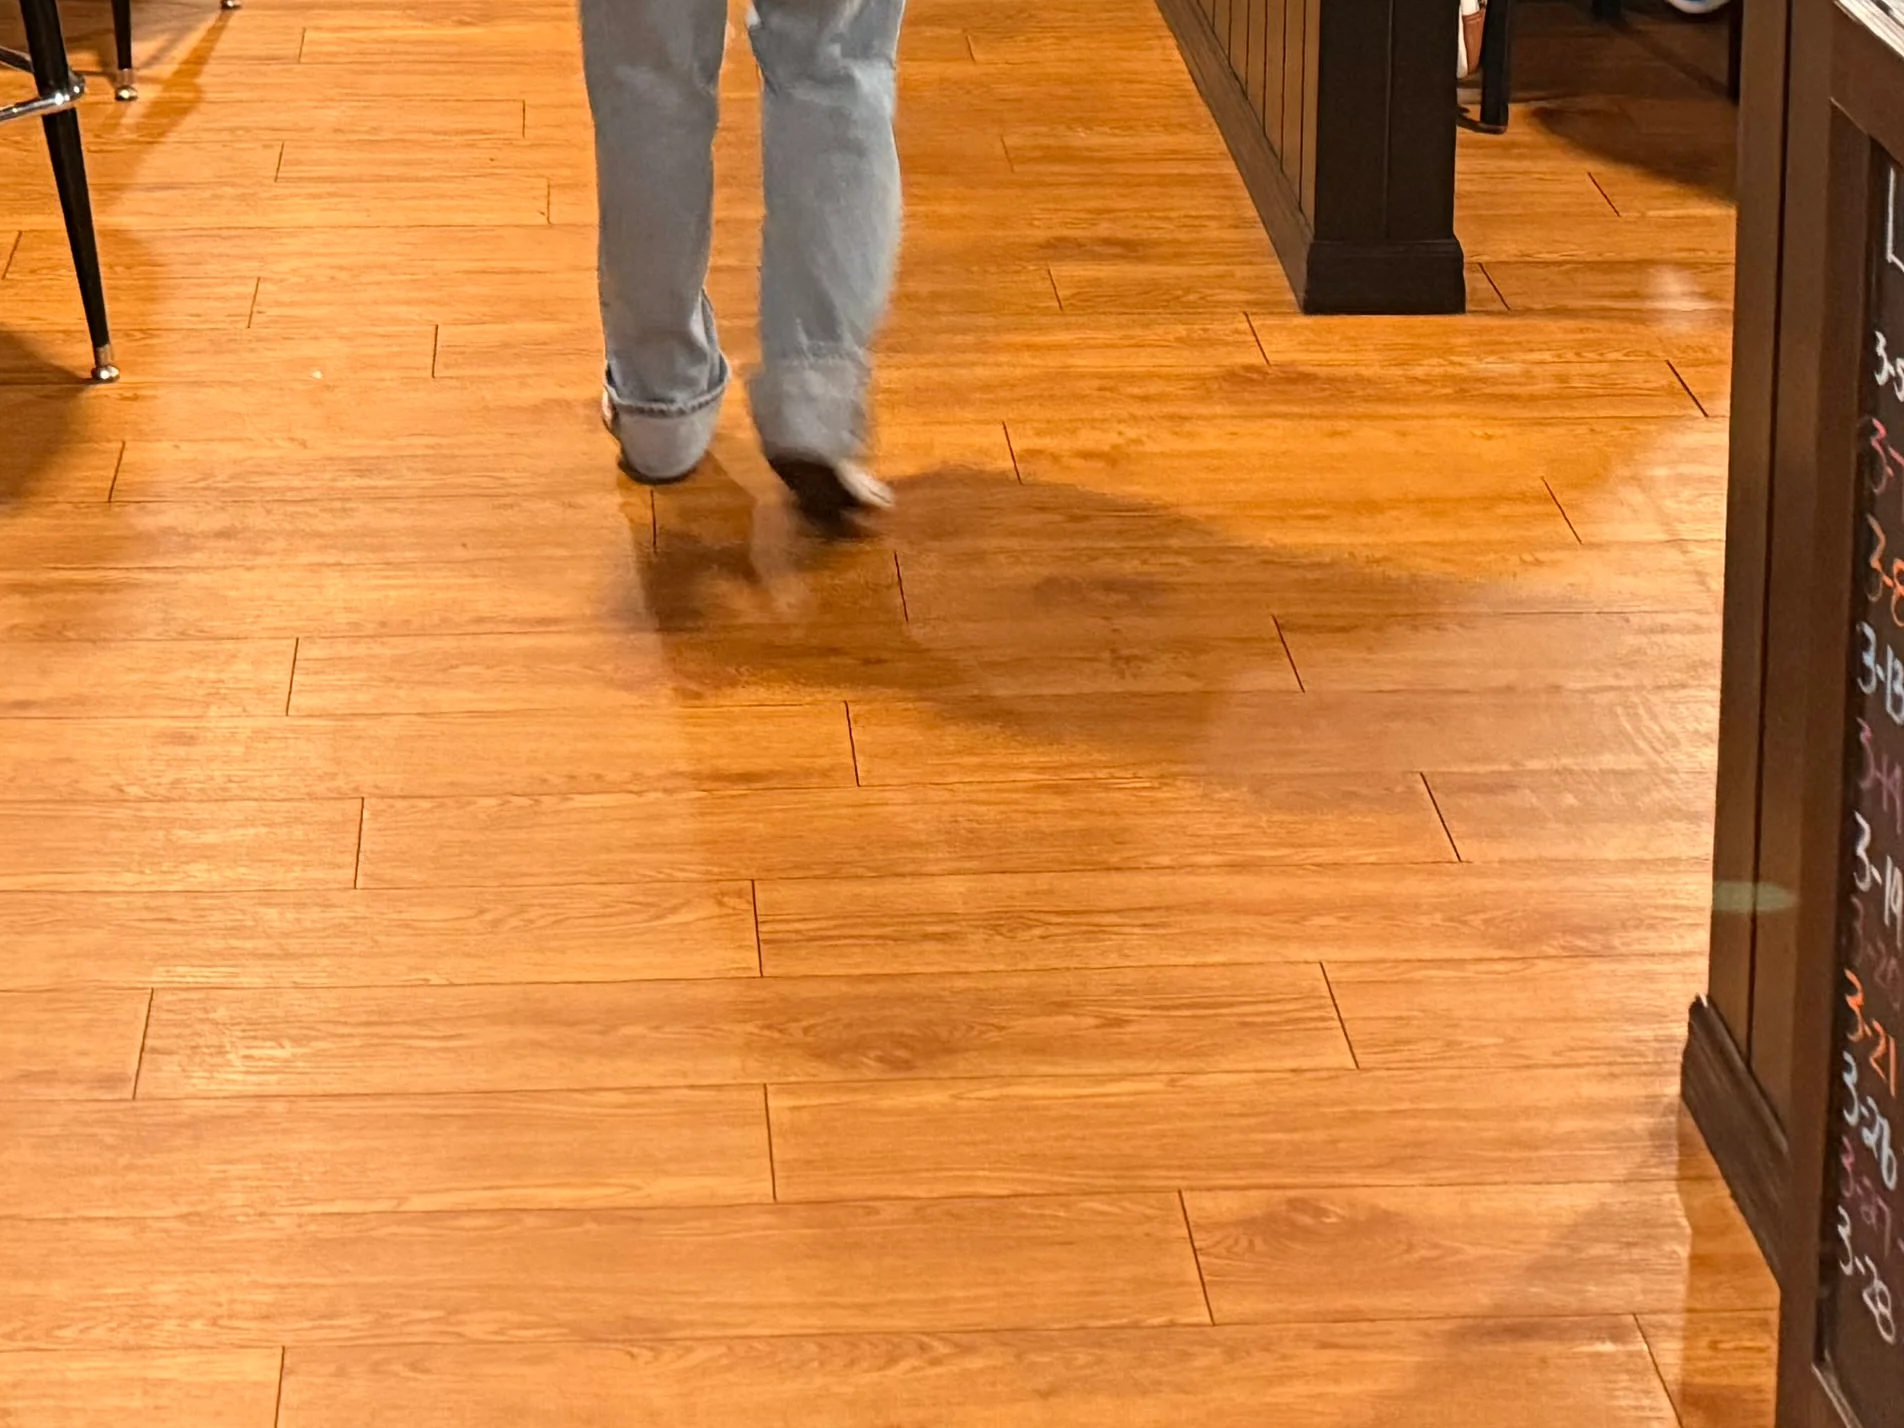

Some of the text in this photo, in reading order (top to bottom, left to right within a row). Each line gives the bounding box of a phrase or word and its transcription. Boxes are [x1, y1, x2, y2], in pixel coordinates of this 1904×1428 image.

[1853, 810, 1903, 949] 3-19
[1844, 969, 1896, 1097] 3-21
[1843, 1050, 1896, 1191] 3-26
[1837, 1205, 1895, 1344] 3-28
